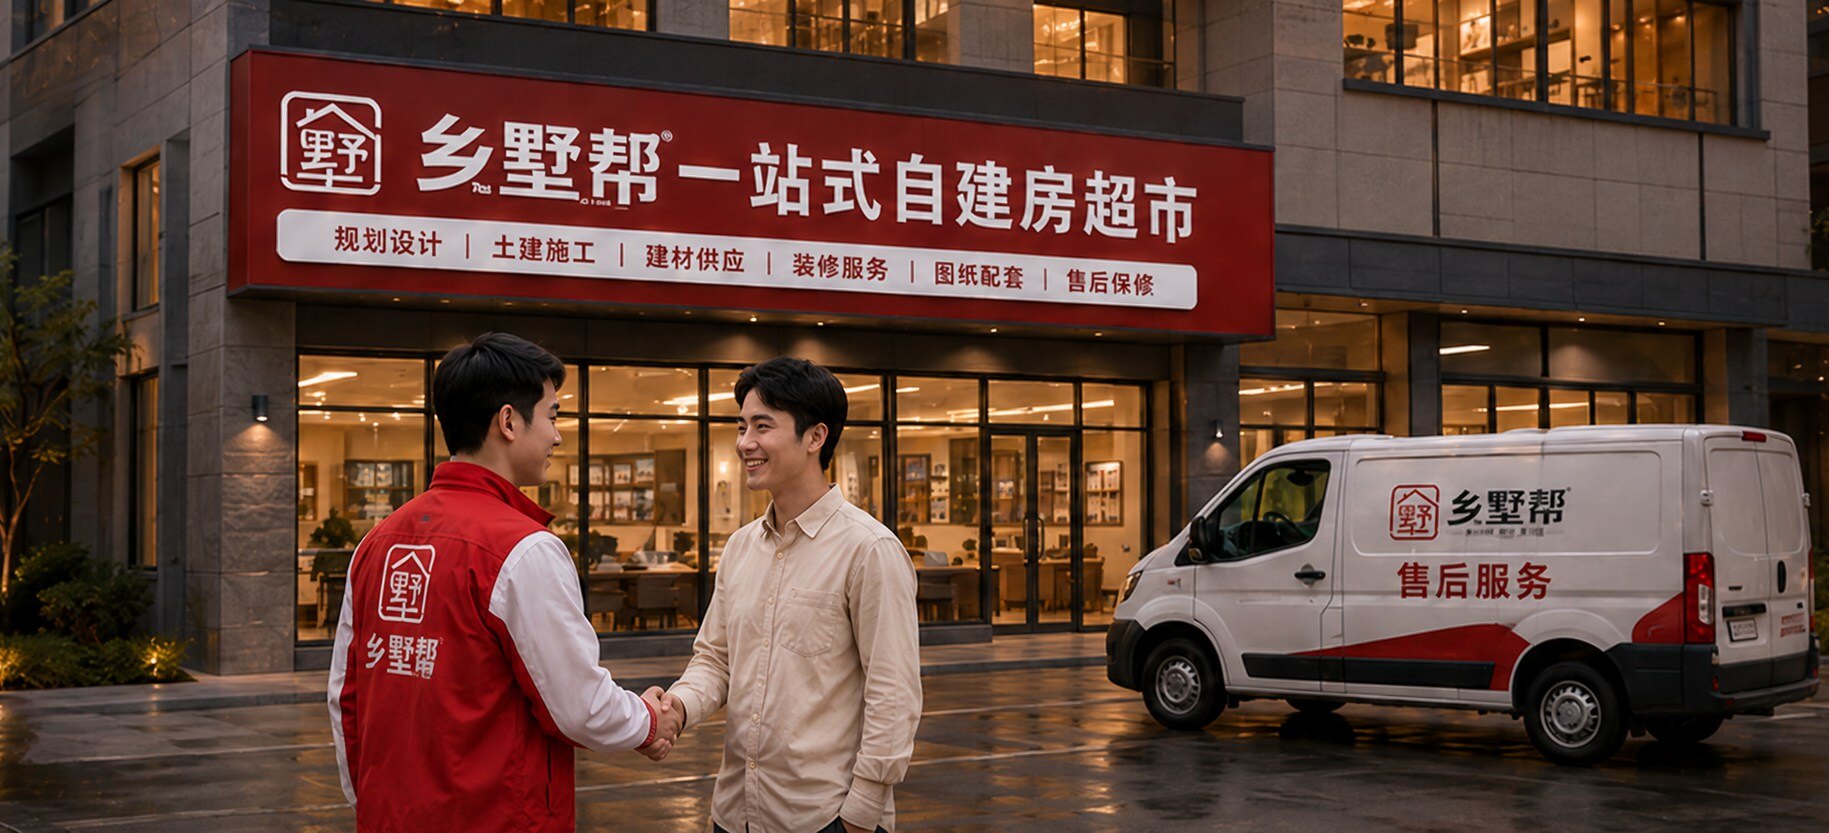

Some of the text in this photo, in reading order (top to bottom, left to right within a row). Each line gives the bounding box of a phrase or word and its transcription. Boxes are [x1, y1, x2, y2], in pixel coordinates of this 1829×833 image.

[416, 112, 1198, 244] 乡墅帮 一站式自建房超市
[334, 225, 1155, 297] 规划设计 土建施工 建材供应 装修服务 图纸配套 售后保修
[1447, 488, 1566, 526] 乡墅帮
[1397, 561, 1552, 600] 售后服务
